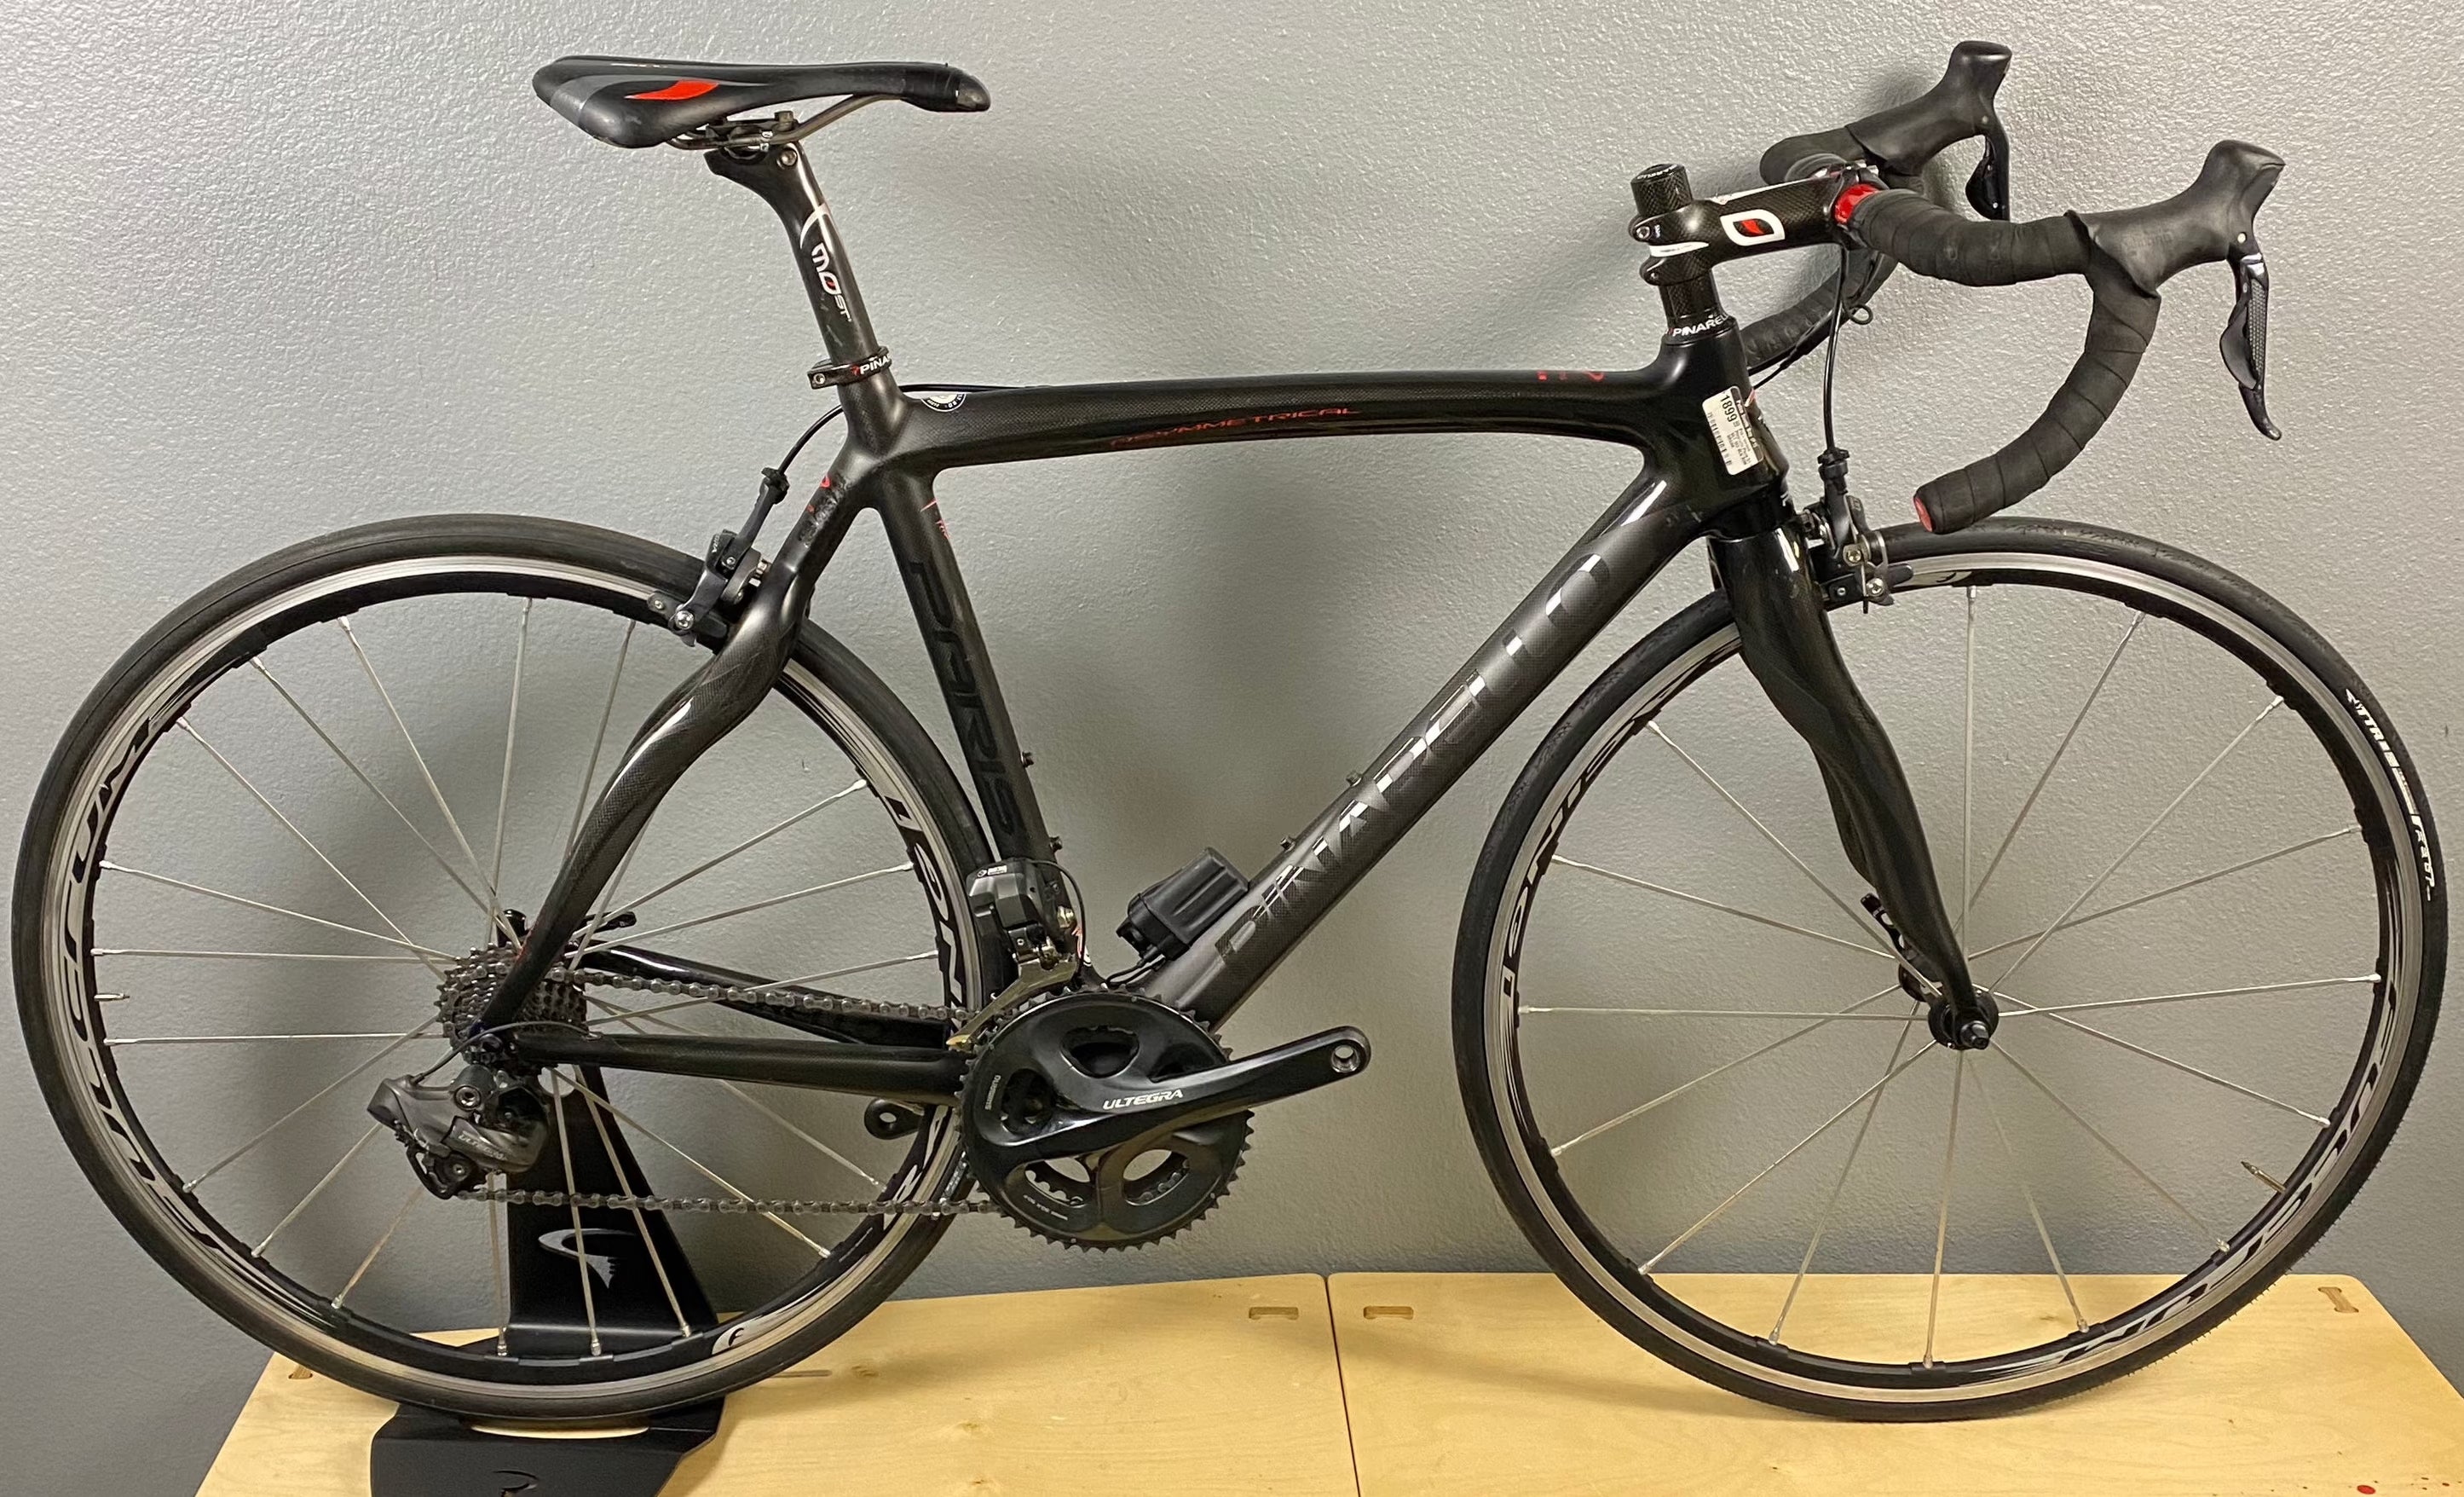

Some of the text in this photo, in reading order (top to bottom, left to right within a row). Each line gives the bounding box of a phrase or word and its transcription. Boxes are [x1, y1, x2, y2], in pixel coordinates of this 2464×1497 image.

[860, 355, 890, 374] PINA
[1720, 394, 1739, 423] 1899
[909, 558, 1025, 842] PARIS
[1215, 552, 1613, 972] PINARELLO
[1103, 1090, 1184, 1110] ULTEGRA
